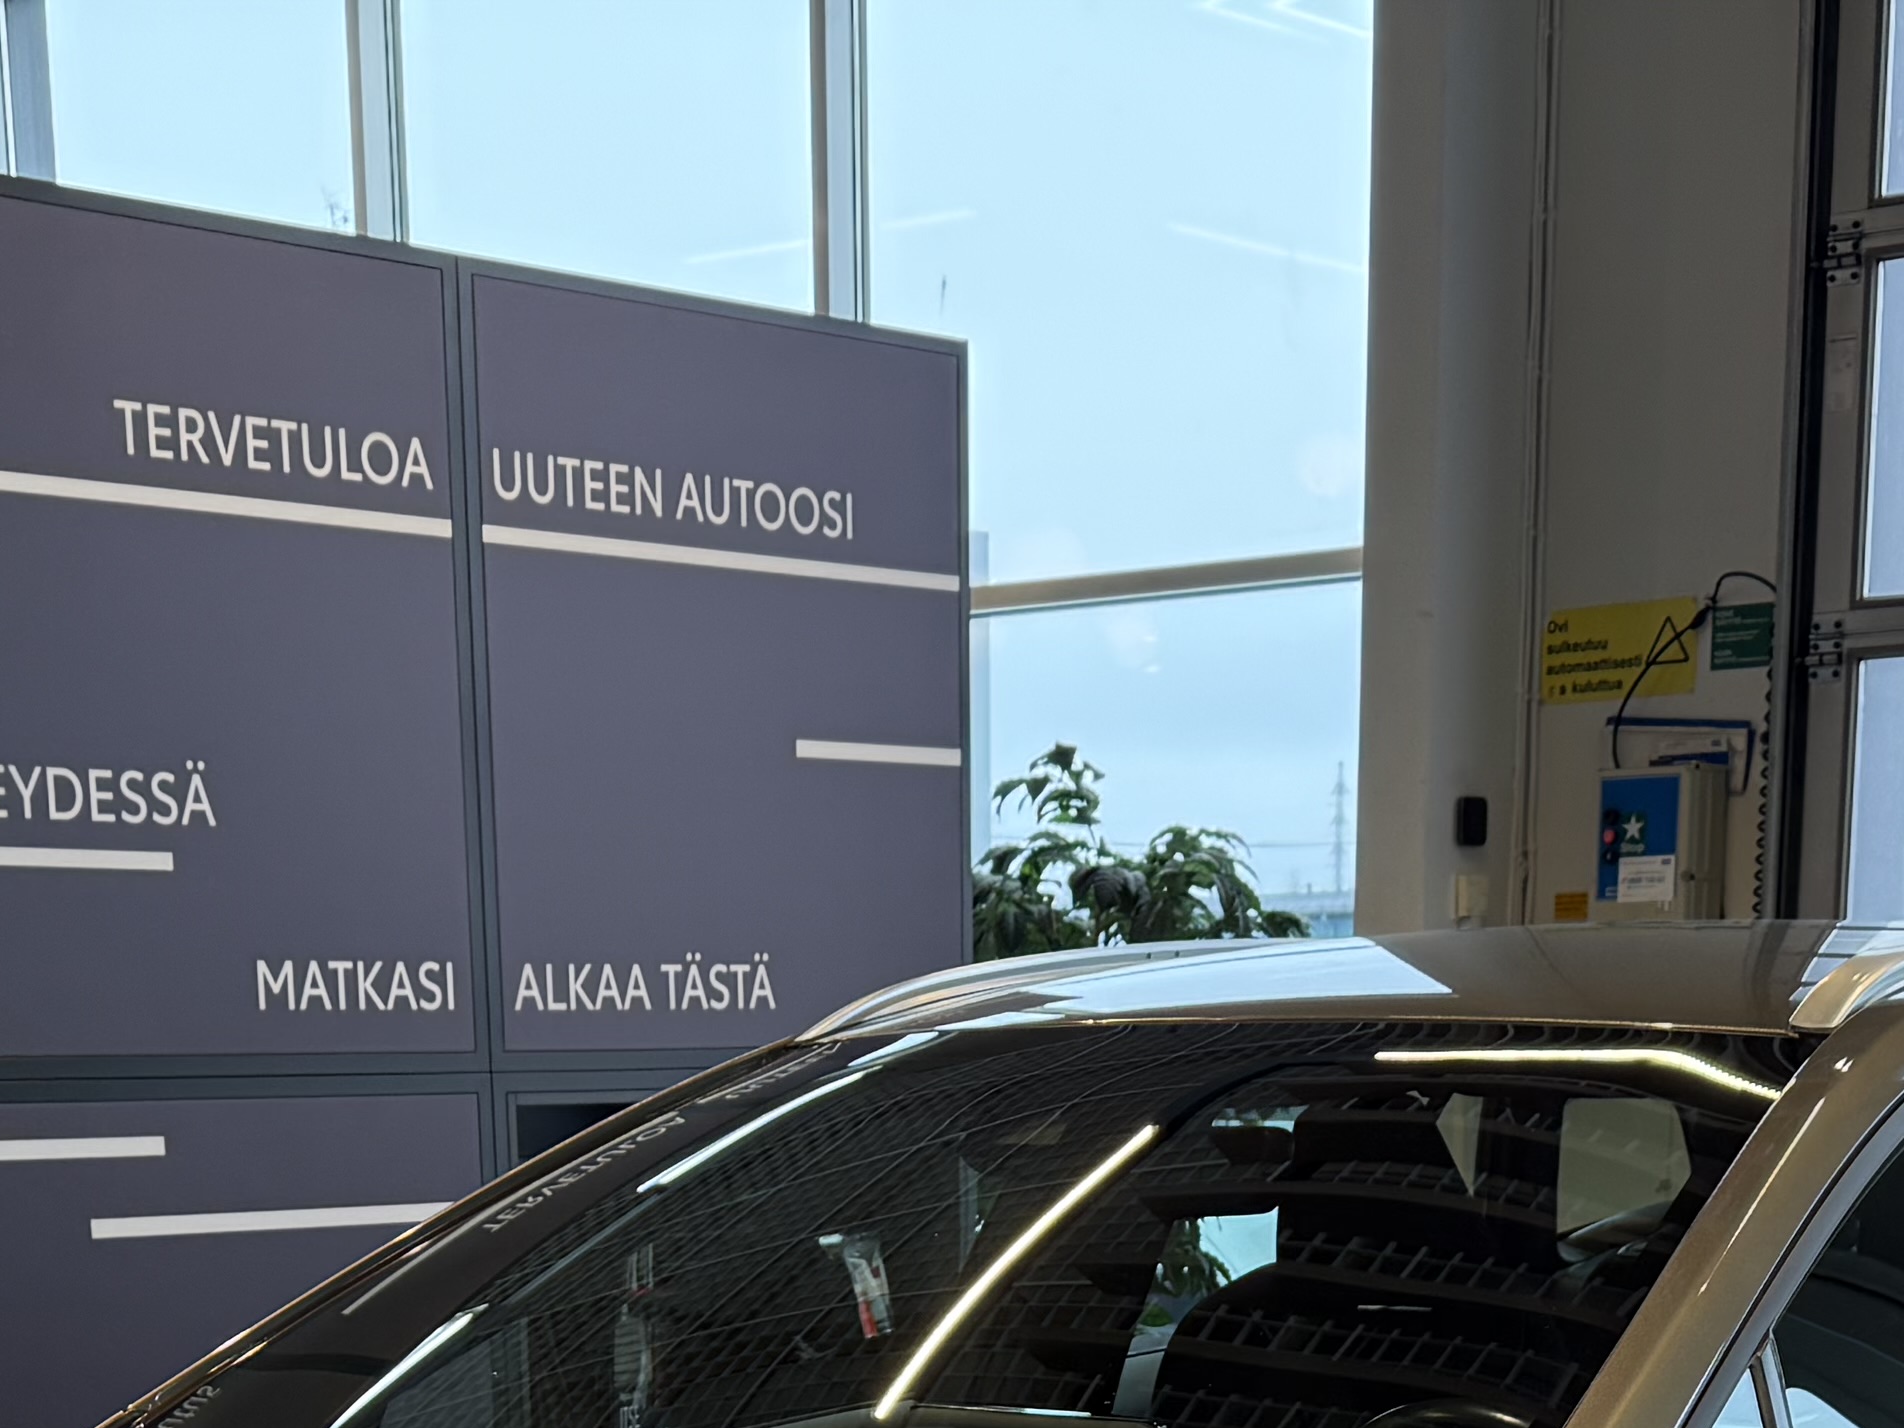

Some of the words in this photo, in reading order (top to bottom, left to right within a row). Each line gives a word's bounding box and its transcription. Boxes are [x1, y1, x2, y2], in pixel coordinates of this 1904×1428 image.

[112, 398, 434, 491] TERVETULOA
[490, 446, 664, 520] UUTEEN
[676, 470, 854, 541] AUTOOSI
[1547, 619, 1569, 634] Ovi
[256, 959, 456, 1012] MATKASI
[514, 962, 652, 1012] ALKAA
[660, 951, 777, 1011] TÄSTÄ
